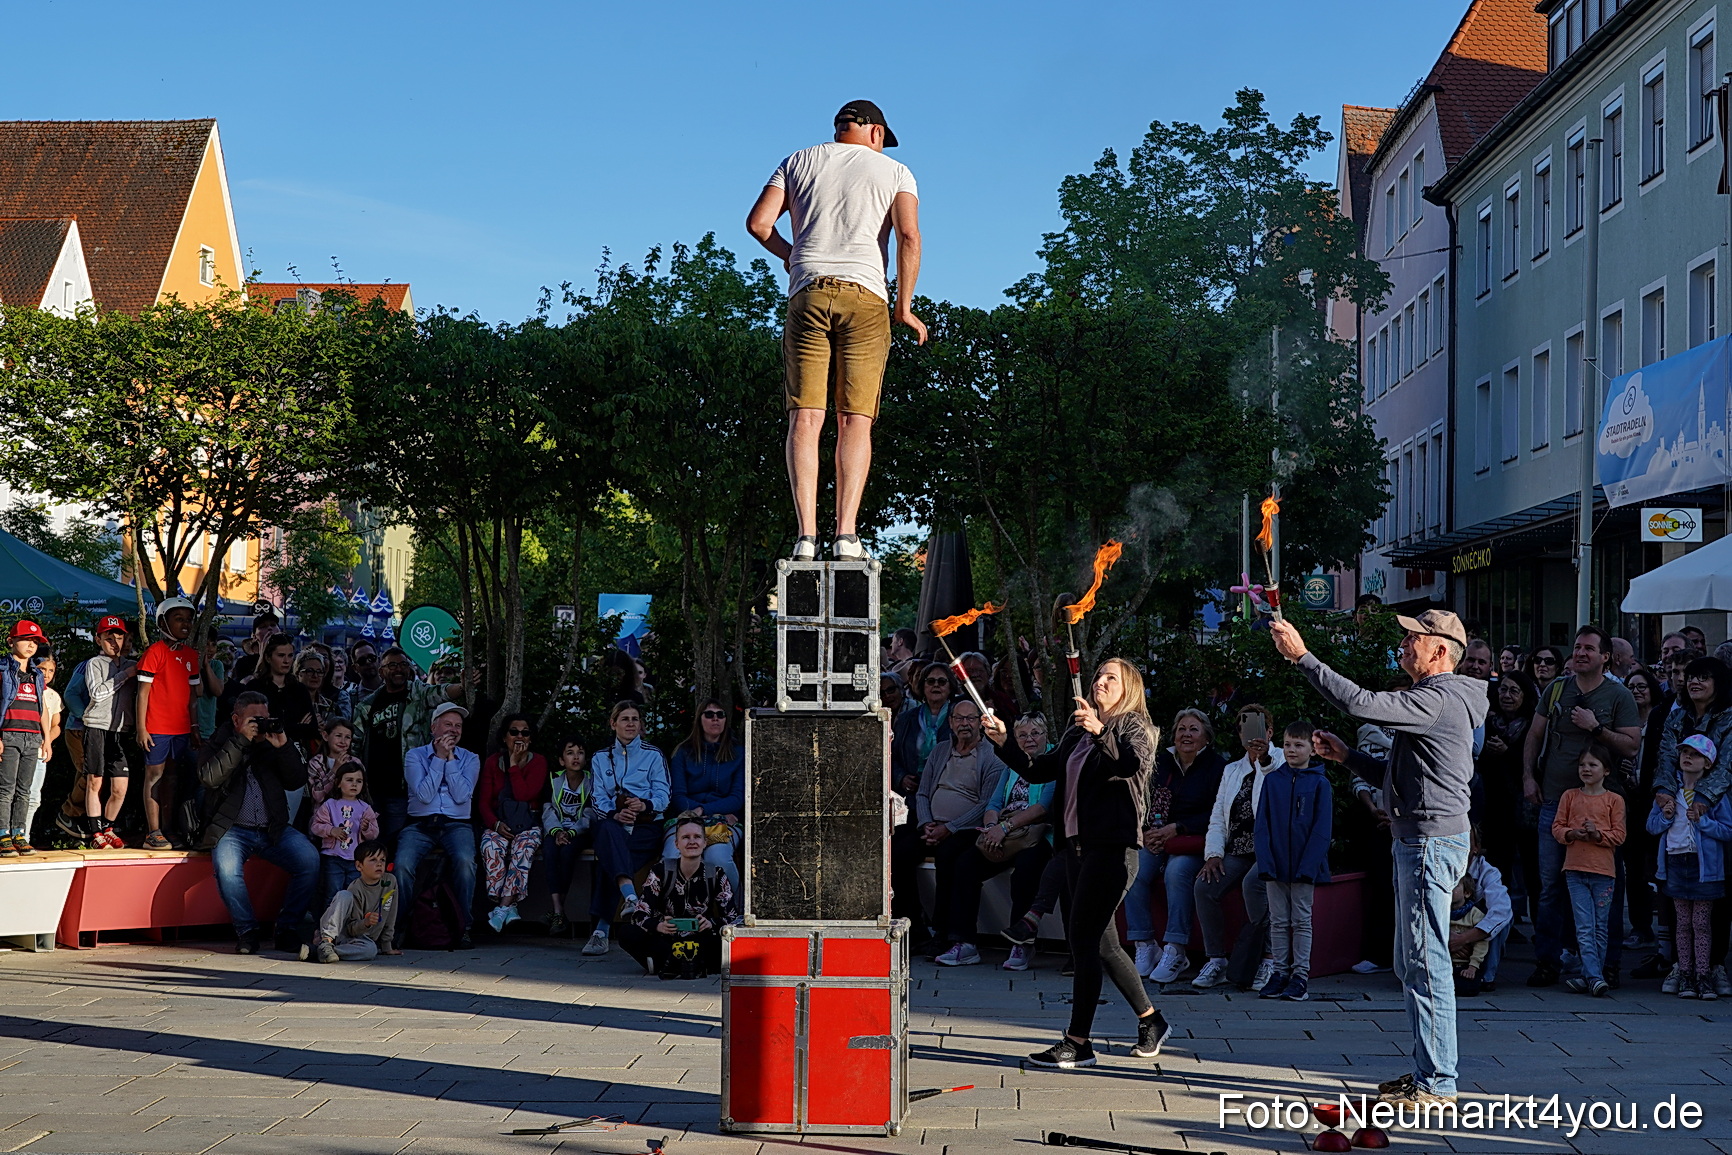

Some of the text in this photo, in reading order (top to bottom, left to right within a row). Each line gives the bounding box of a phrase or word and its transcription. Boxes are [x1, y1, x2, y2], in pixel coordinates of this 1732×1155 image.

[1605, 415, 1647, 439] STADTRADELN
[1648, 520, 1697, 530] SONNECHKO
[1452, 547, 1492, 575] SONNECHKO
[108, 617, 119, 626] M
